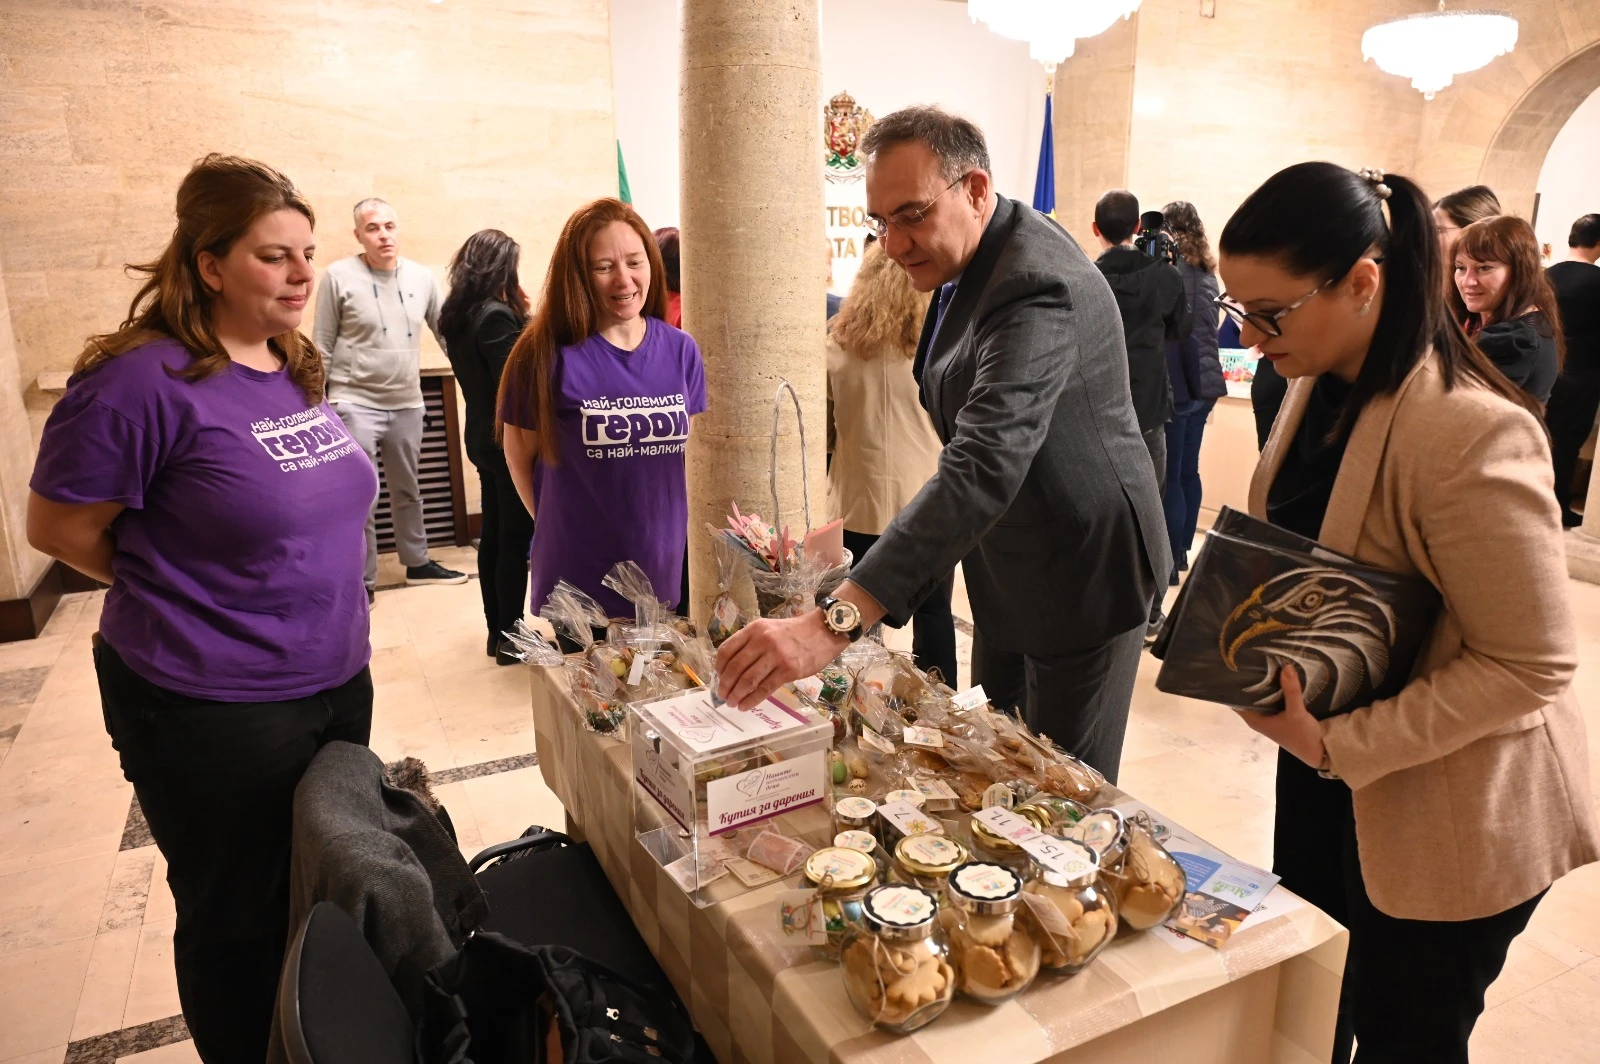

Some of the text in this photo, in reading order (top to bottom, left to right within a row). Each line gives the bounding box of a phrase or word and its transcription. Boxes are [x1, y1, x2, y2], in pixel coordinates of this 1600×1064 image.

[826, 205, 866, 228] ТВО
[583, 393, 684, 410] най-големите
[250, 406, 322, 433] най-големите
[585, 410, 688, 444] герои
[258, 420, 347, 460] герои
[280, 442, 359, 473] са най-малките
[586, 448, 604, 459] са
[719, 807, 757, 825] Кутия
[758, 802, 771, 816] за
[773, 788, 815, 810] дарения
[894, 812, 910, 820] 7
[990, 814, 1012, 827] 11
[1039, 845, 1065, 861] 15
